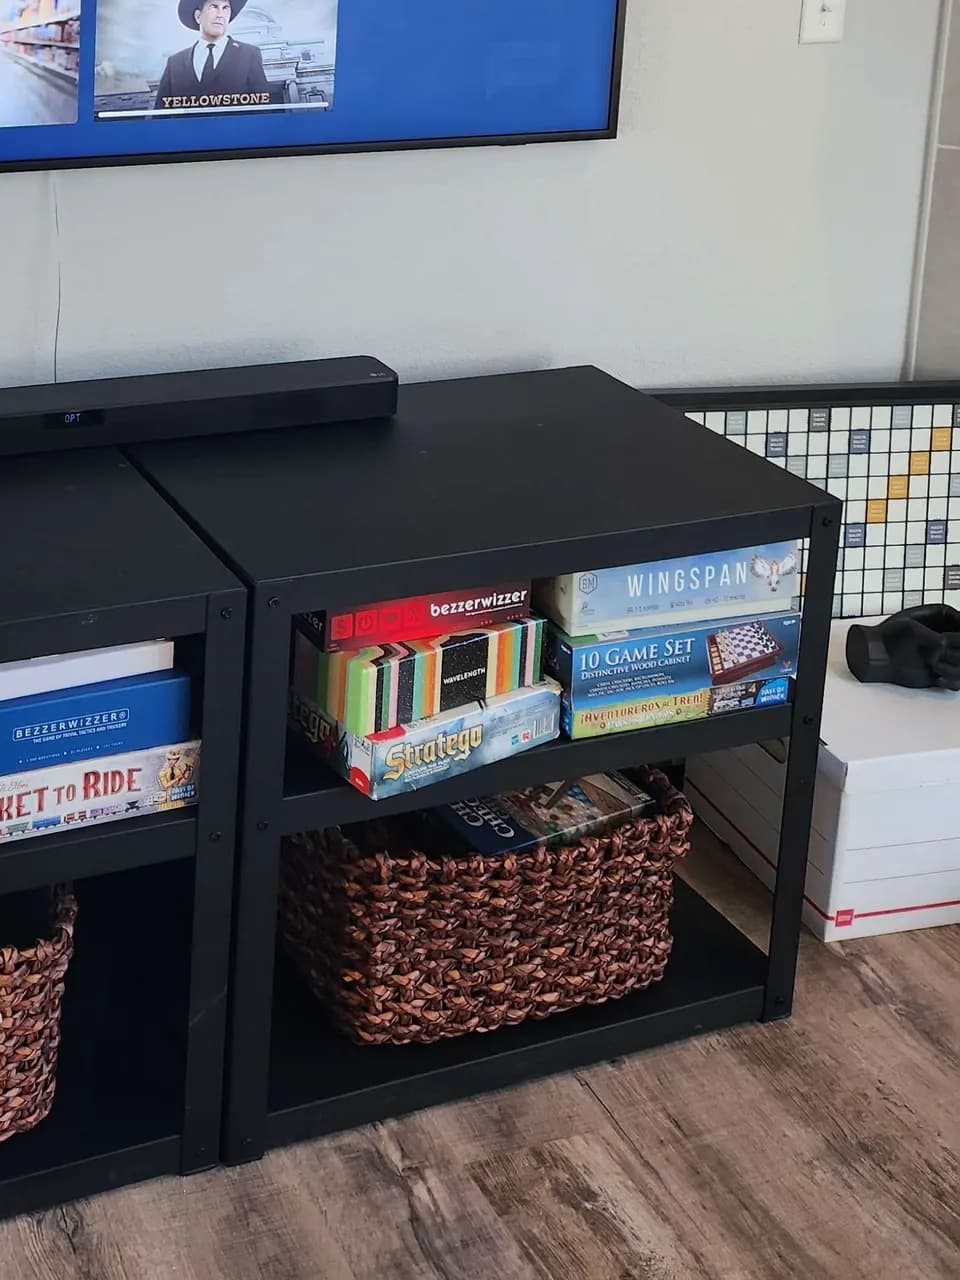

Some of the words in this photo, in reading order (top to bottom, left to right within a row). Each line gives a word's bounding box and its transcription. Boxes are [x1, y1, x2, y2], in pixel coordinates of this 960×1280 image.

[161, 92, 270, 108] YELLOWSTONE
[627, 561, 748, 598] WINGSPAN
[430, 589, 528, 617] bezzerwizzer
[580, 651, 600, 671] 10
[605, 642, 658, 666] GAME
[665, 637, 696, 655] SET
[581, 663, 630, 681] DISTINCTIVE
[630, 659, 657, 671] WOOD
[658, 655, 691, 667] CABINET
[442, 667, 486, 685] WAVELENGTH
[15, 711, 117, 738] BEZZERWIZZER
[382, 723, 484, 781] Stratego
[53, 783, 76, 805] TO
[82, 768, 142, 801] RIDE
